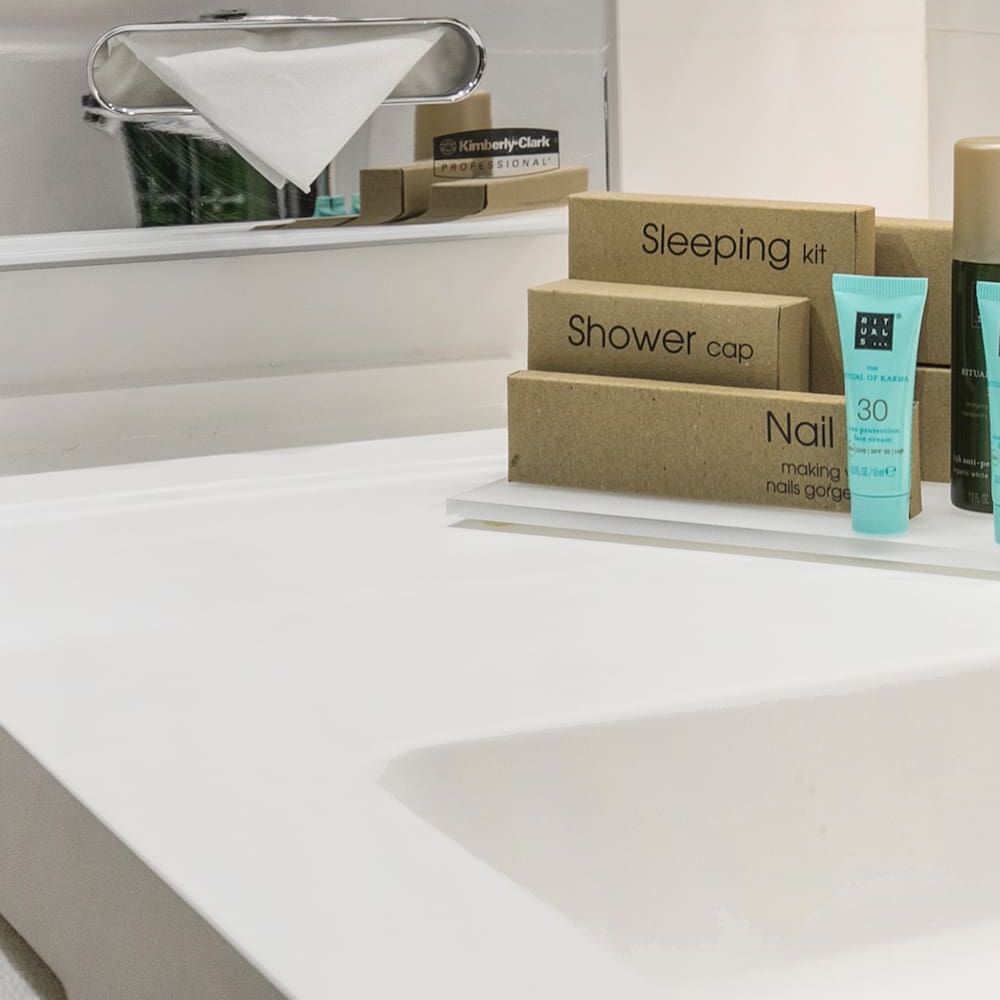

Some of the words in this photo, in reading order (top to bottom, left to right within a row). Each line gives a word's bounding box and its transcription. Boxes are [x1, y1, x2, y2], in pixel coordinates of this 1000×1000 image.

[441, 159, 547, 172] PROFESSIONAL
[642, 222, 791, 270] Sleeping
[802, 244, 827, 264] kit
[568, 314, 696, 354] Shower
[706, 340, 754, 364] cap
[866, 374, 878, 382] OF
[961, 368, 986, 378] RITUA
[857, 398, 888, 422] 30
[766, 410, 834, 448] Nail
[781, 462, 840, 482] making
[962, 458, 990, 470] anti-pe
[766, 480, 800, 496] nails
[804, 484, 850, 502] gorge
